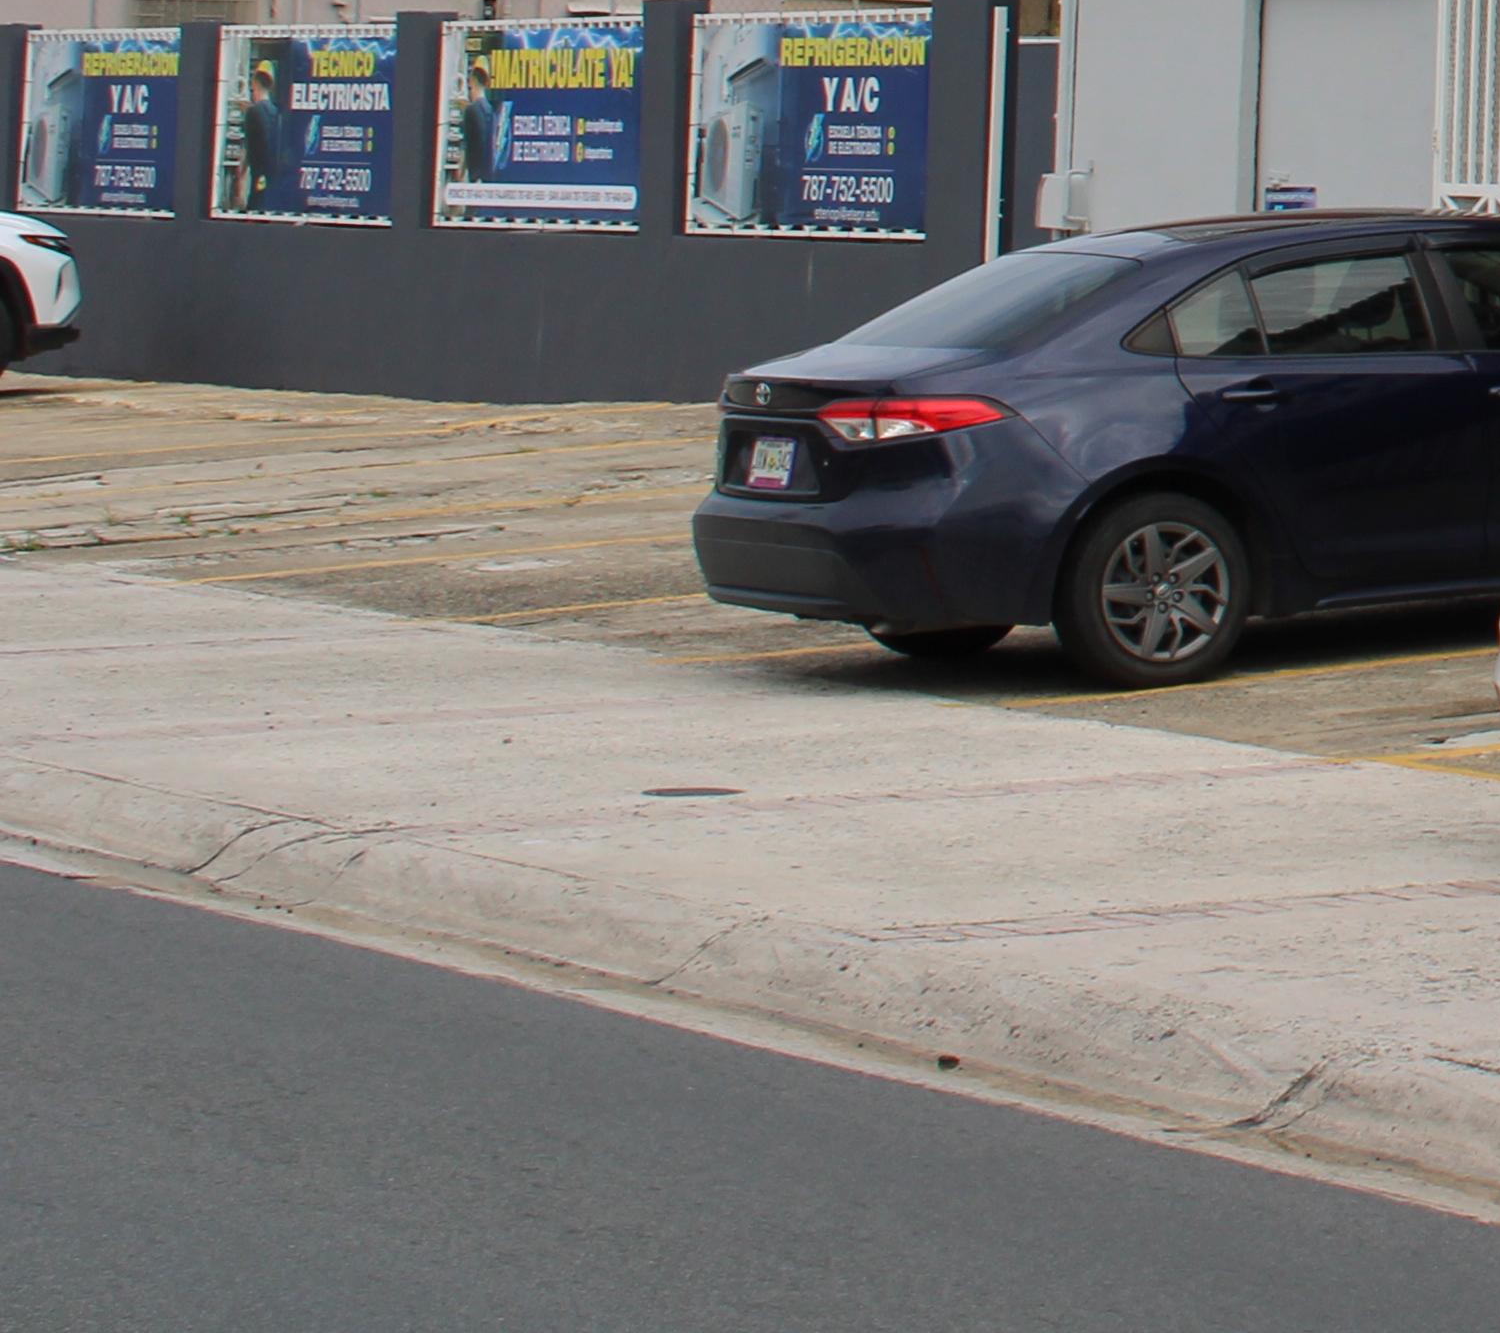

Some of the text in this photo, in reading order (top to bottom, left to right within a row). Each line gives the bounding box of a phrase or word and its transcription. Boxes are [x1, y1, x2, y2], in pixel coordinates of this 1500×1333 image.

[781, 29, 927, 66] REFRIGERACIÓN
[610, 47, 636, 89] YA!
[290, 83, 390, 110] ELECTRICISTA
[823, 76, 880, 113] Y A/C
[300, 167, 372, 191] 787-752-5500
[802, 175, 893, 203] 787-752-5500
